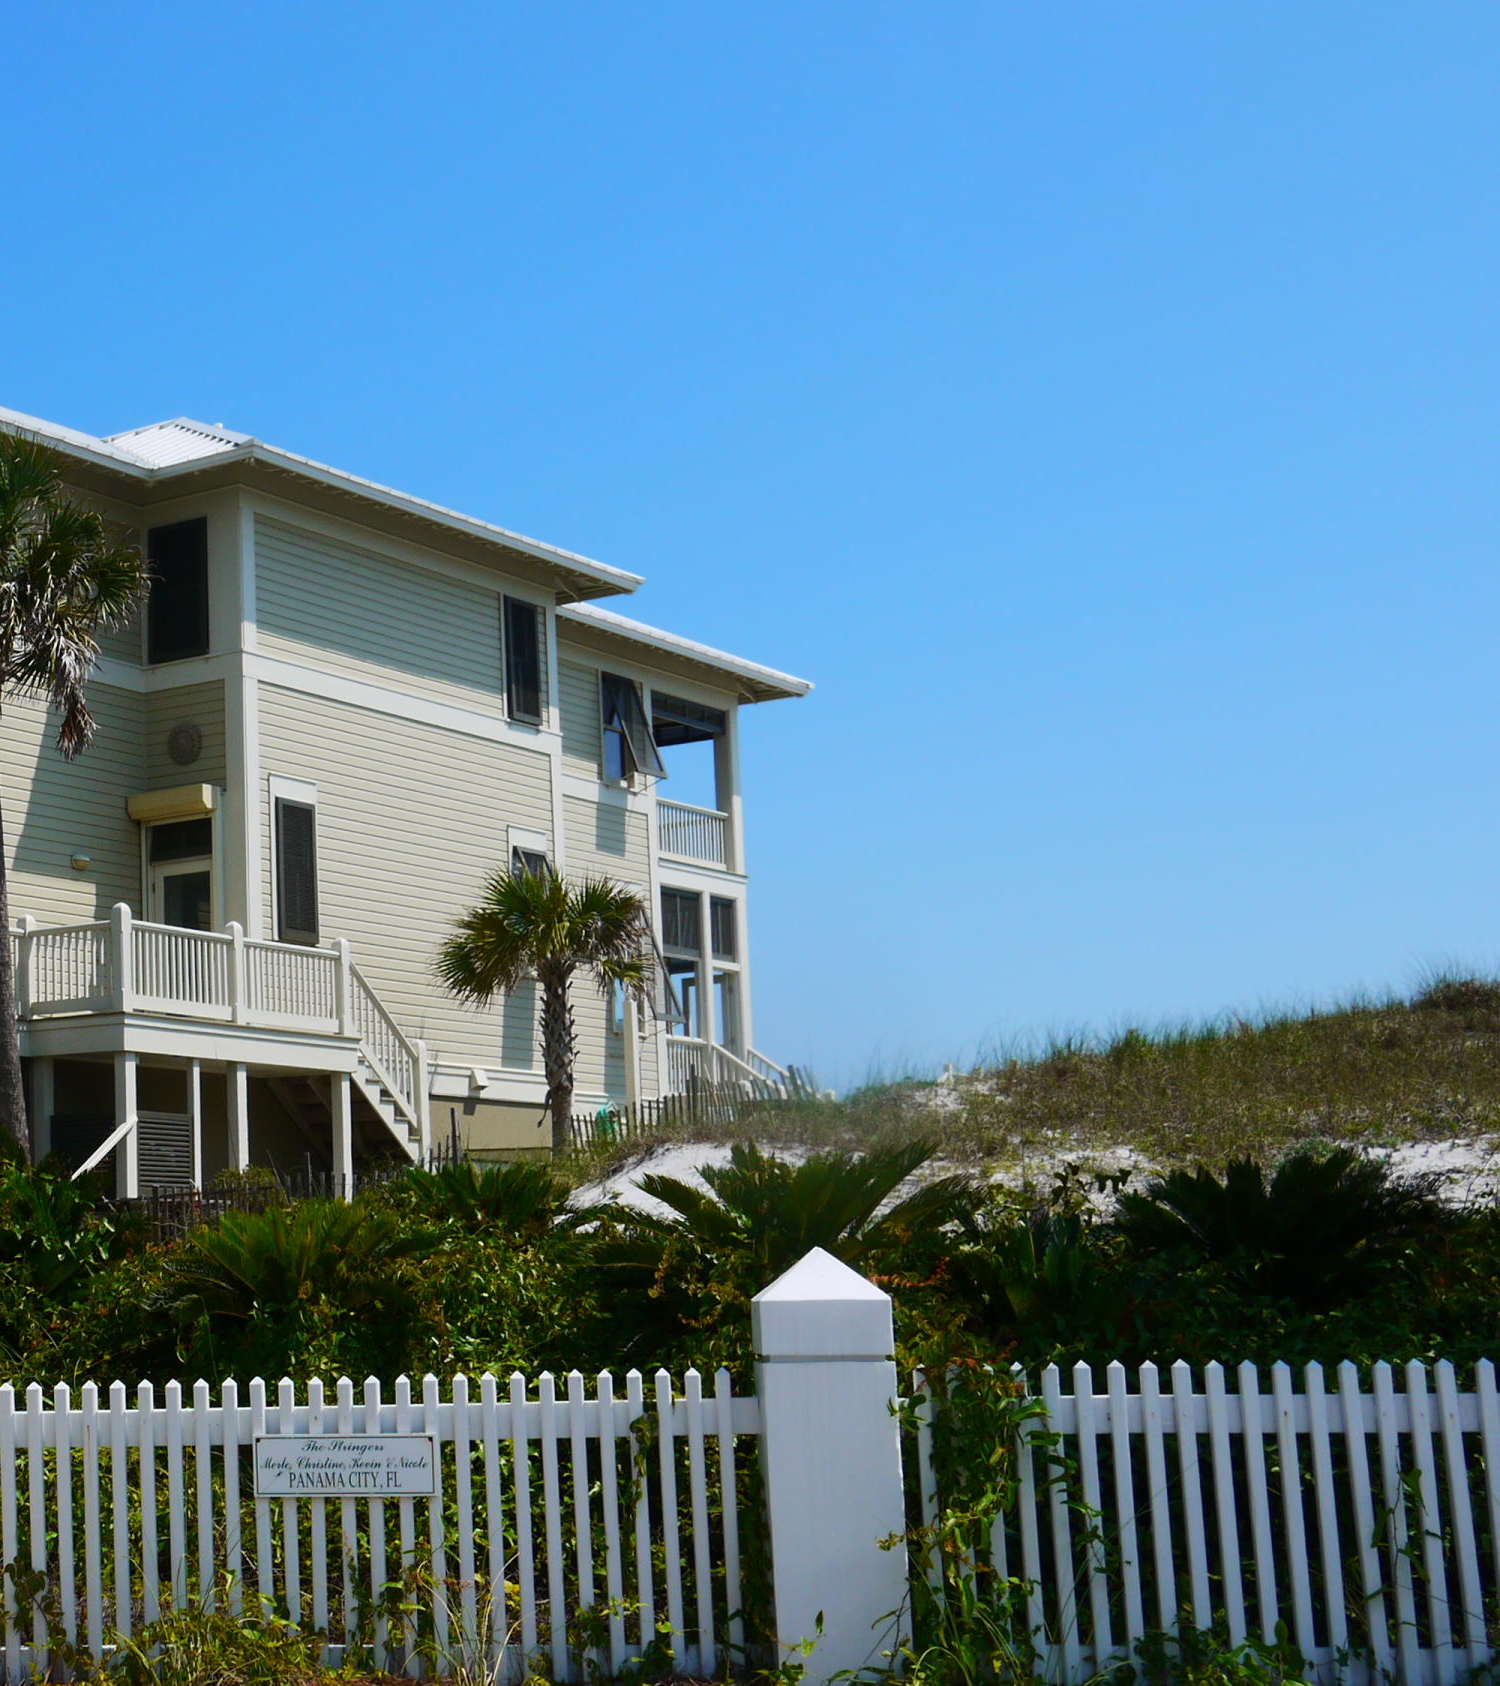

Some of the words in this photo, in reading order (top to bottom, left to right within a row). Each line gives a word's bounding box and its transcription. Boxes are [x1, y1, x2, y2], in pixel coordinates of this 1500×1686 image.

[301, 1440, 325, 1452] The
[327, 1440, 384, 1455] Stringers
[296, 1456, 346, 1470] Christine,
[349, 1457, 381, 1469] Kevin
[395, 1456, 428, 1468] Nicole
[289, 1471, 346, 1489] PANAMA
[348, 1471, 383, 1488] CITY,
[386, 1471, 402, 1488] FL
